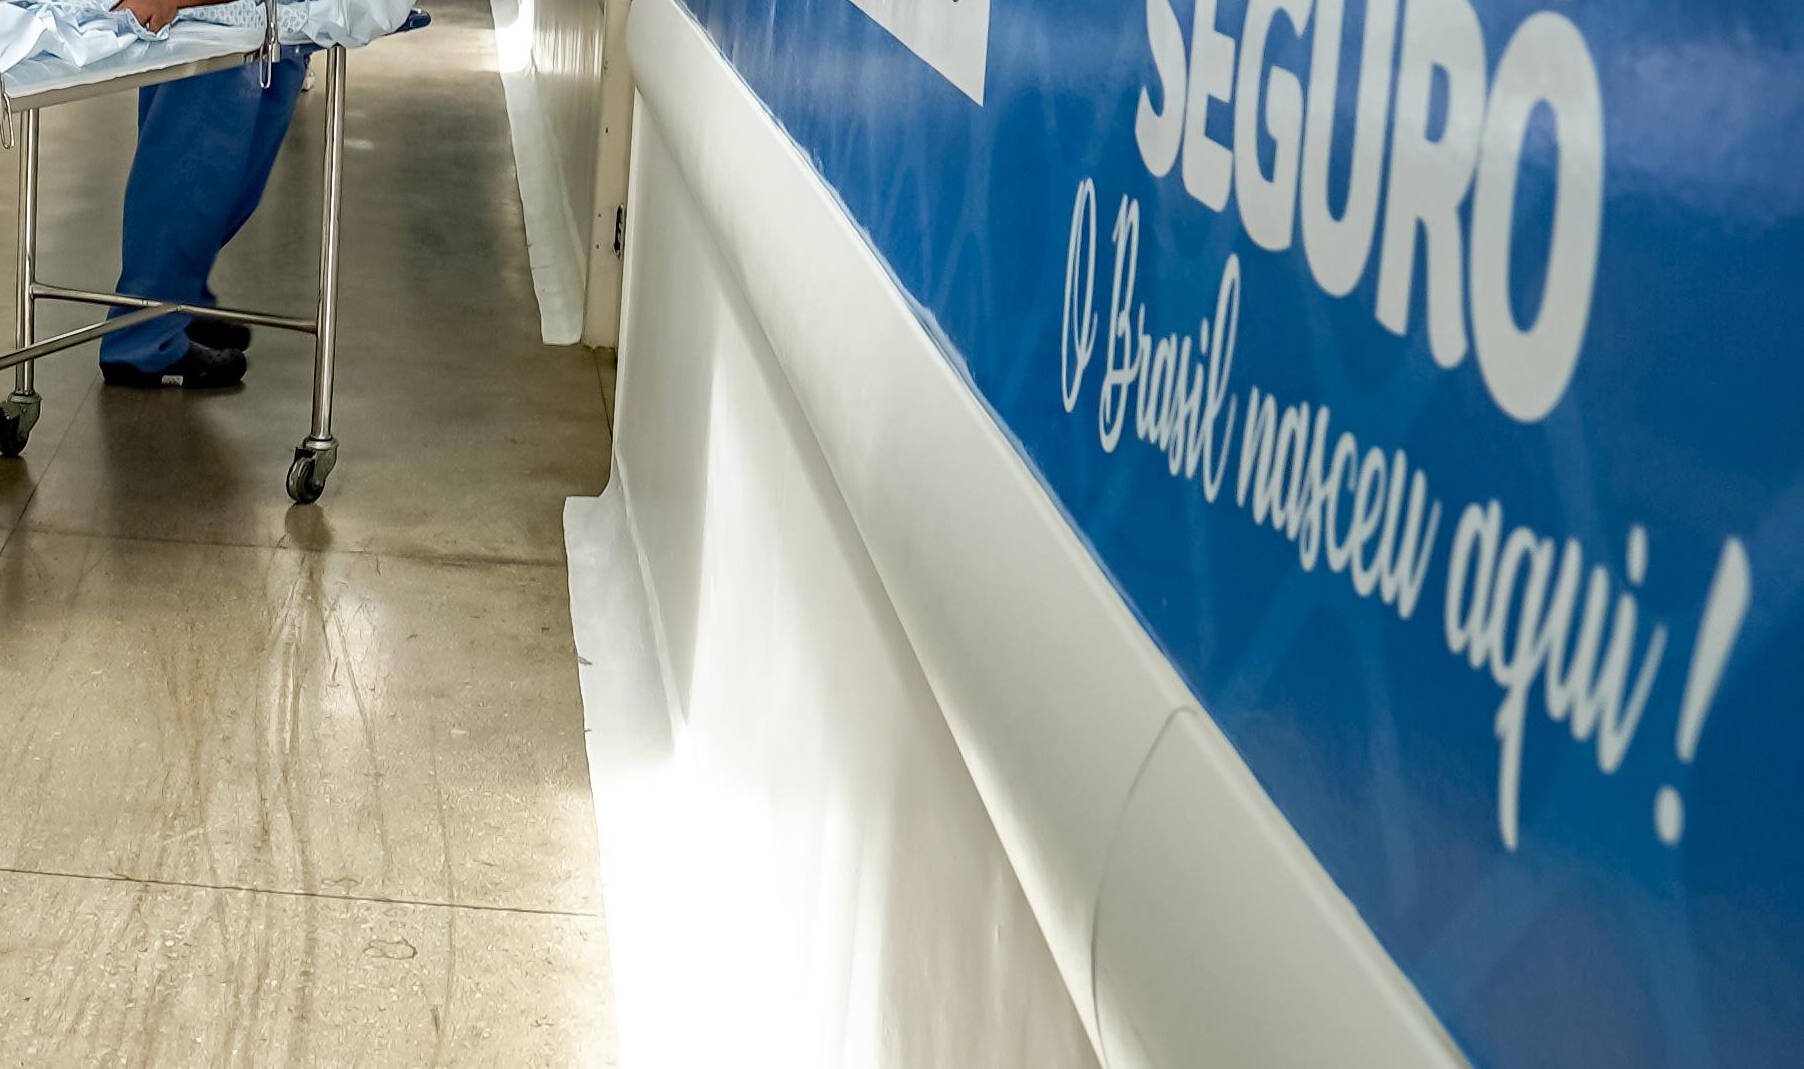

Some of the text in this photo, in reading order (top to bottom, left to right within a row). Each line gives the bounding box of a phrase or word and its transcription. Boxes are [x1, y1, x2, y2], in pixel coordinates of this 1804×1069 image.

[1061, 177, 1098, 413] O
[1099, 193, 1241, 503] Brasil
[1236, 385, 1442, 620] nasceu
